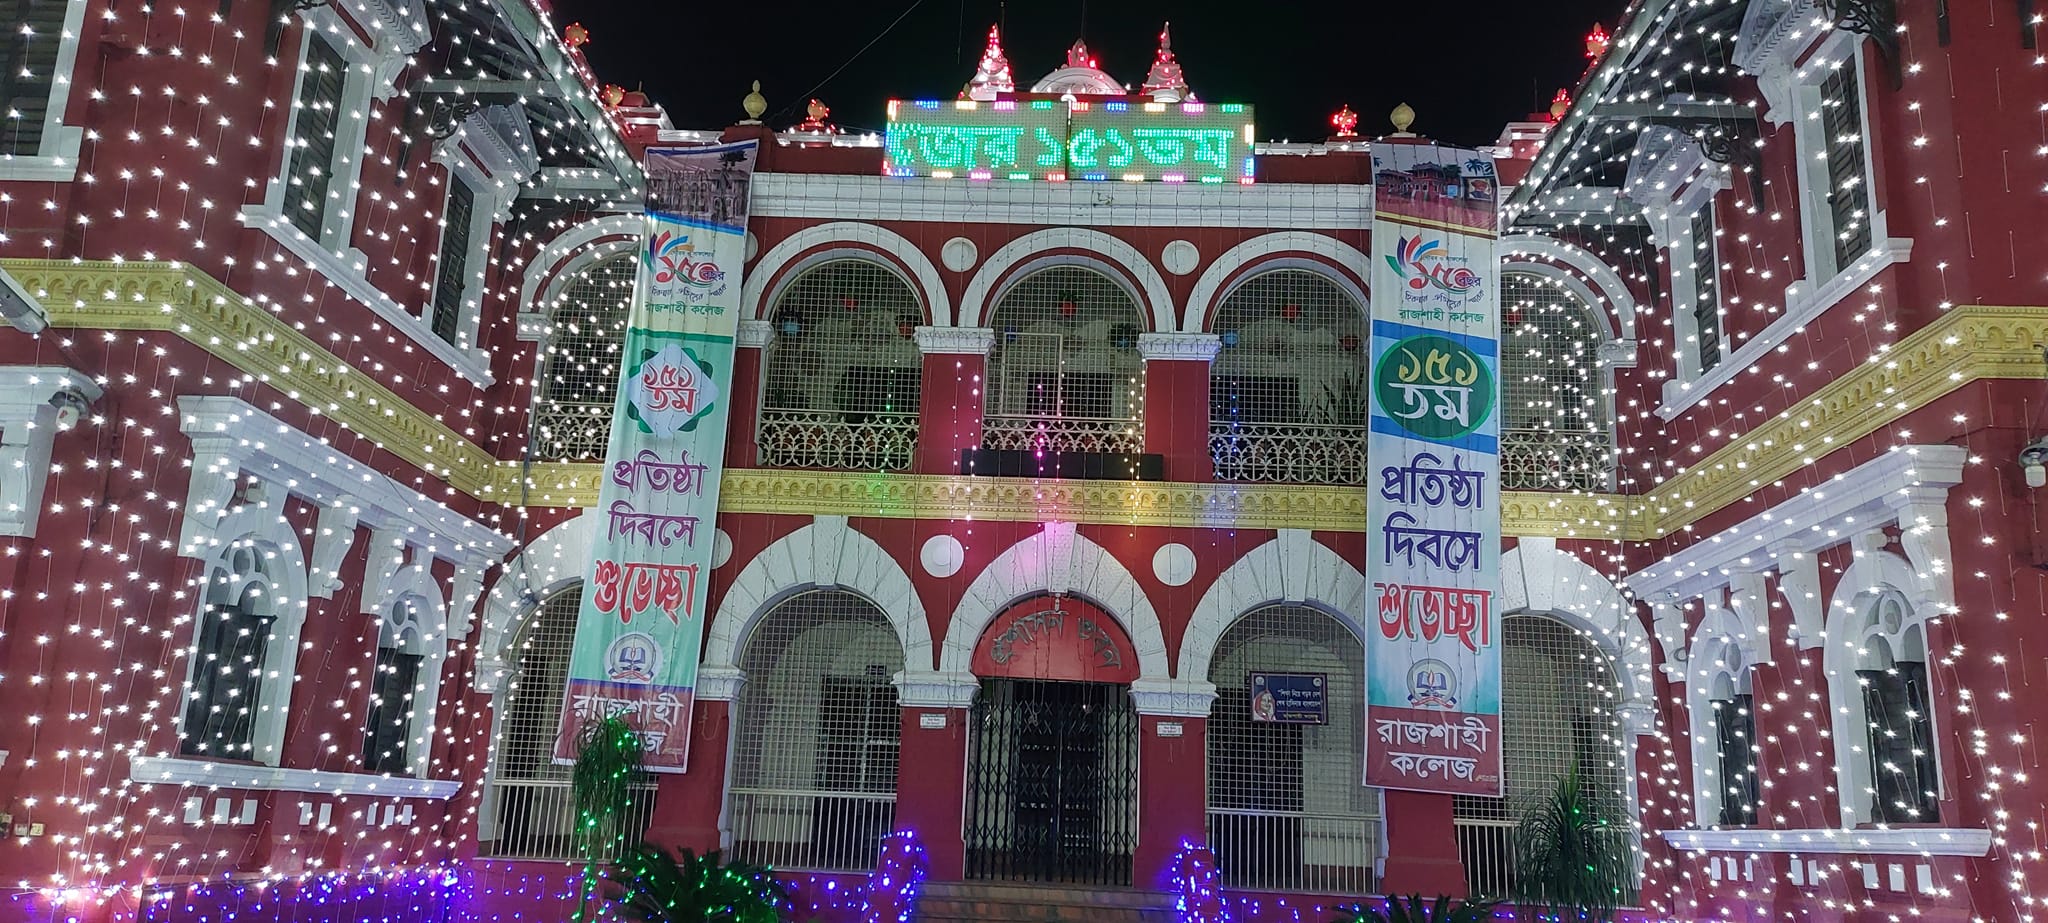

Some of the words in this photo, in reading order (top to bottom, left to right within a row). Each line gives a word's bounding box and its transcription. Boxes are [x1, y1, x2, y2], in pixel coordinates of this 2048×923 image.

[1034, 127, 1235, 169] ১৫১তম
[702, 270, 726, 282] বছর
[1458, 277, 1482, 288] বছর
[645, 301, 687, 314] রাজশাহী
[690, 305, 726, 316] কলেজ
[1398, 307, 1445, 321] রাজশাহী
[1449, 311, 1486, 323] কলেজ
[643, 363, 696, 388] ১৫১
[1398, 347, 1479, 385] ১৫১
[643, 386, 698, 415] তম
[1387, 382, 1474, 428] তম
[612, 449, 709, 497] প্রতিষ্ঠা
[1380, 452, 1488, 509] প্রতিষ্ঠা
[607, 500, 702, 548] দিবসে
[1382, 511, 1484, 571] দিবসে
[593, 559, 700, 625] শুভেচ্ছা
[1374, 582, 1495, 653] শুভেচ্ছা
[572, 692, 684, 728] রাজশাহী
[1374, 716, 1492, 752] রাজশাহী
[1387, 751, 1478, 782] কলেজ
